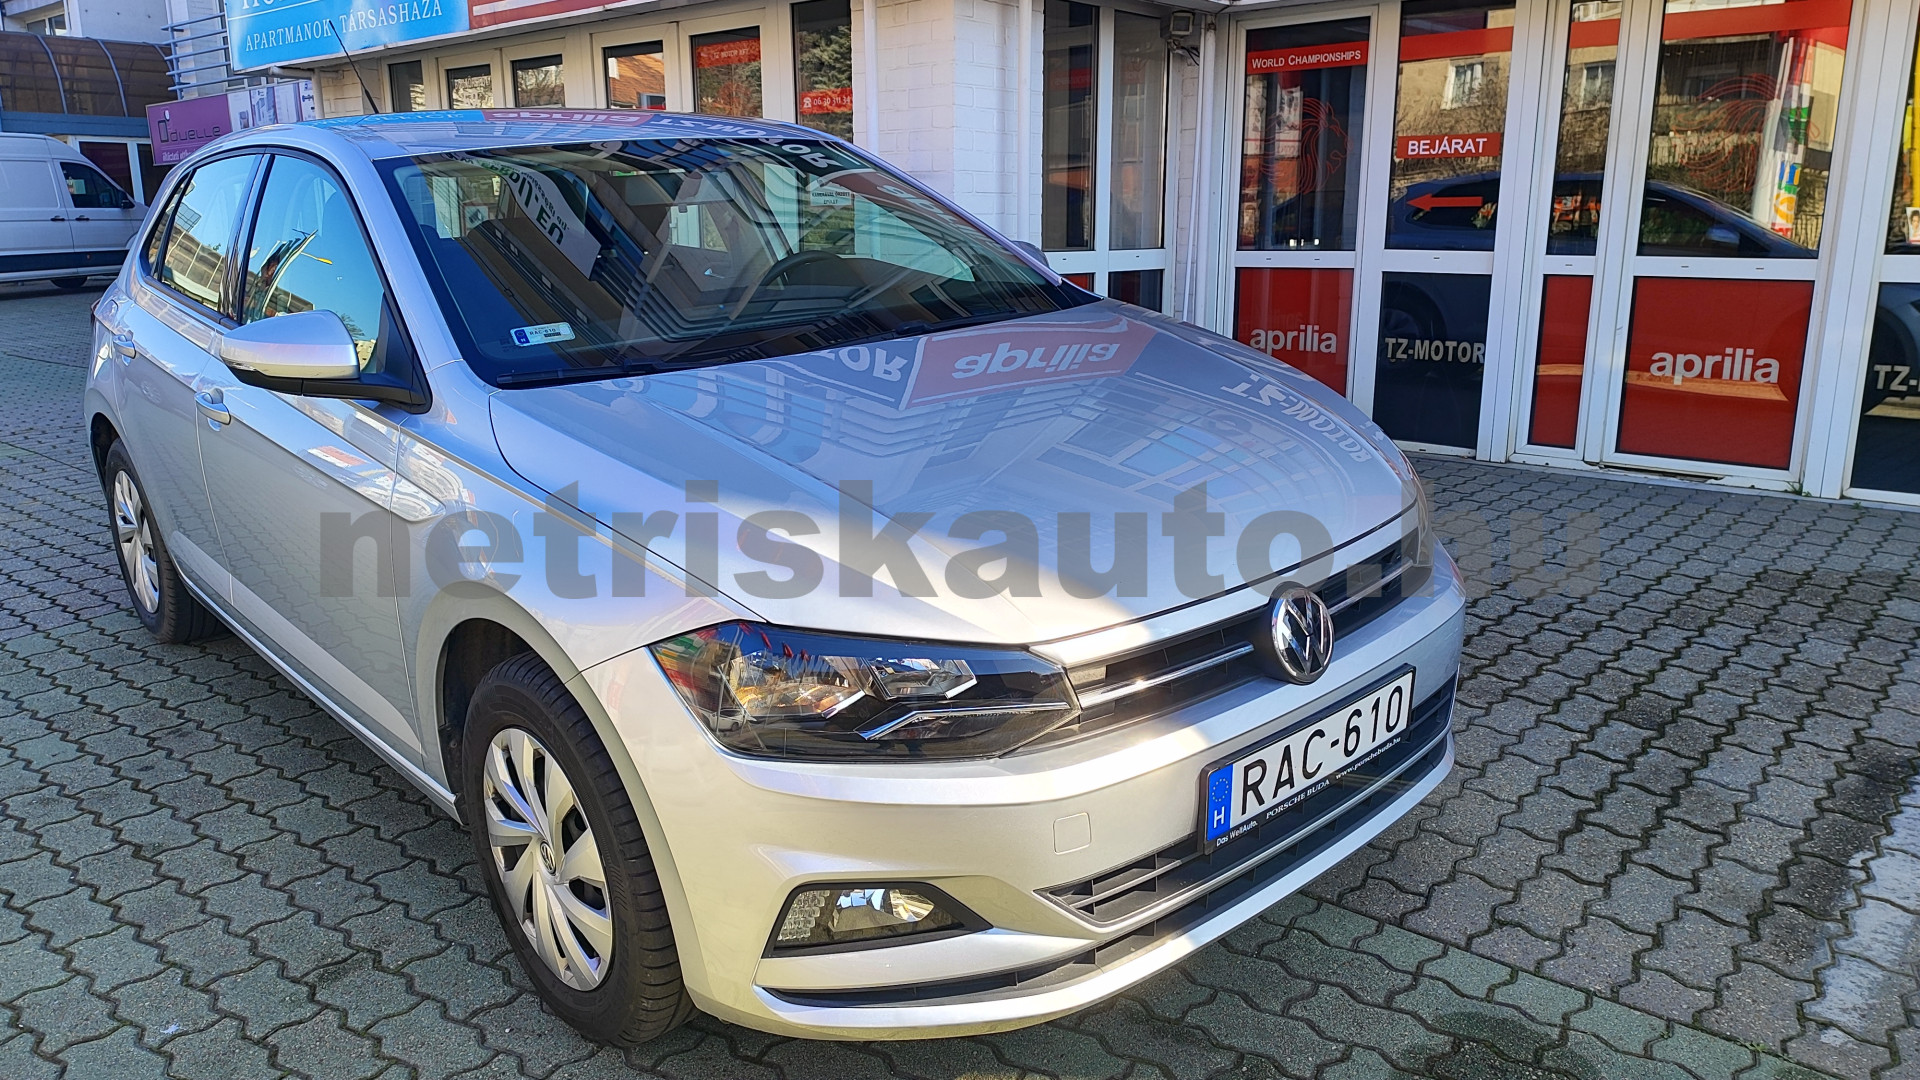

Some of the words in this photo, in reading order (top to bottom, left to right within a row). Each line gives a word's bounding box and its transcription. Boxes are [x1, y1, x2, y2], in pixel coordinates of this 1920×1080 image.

[246, 19, 332, 51] APARTMANOK
[813, 97, 822, 105] 06
[1408, 136, 1487, 155] BEJÁRAT
[1250, 325, 1337, 354] aprilia
[1385, 337, 1486, 364] TZ-MOTOR
[1650, 347, 1780, 385] aprilia
[1874, 364, 1920, 392] TZ-
[1241, 685, 1403, 816] RAC-610
[1336, 737, 1401, 780] www.porschebuda.hu
[1213, 806, 1225, 828] H
[1216, 832, 1229, 847] Das
[1266, 792, 1306, 819] PORSCHE
[1306, 779, 1330, 796] BUDA
